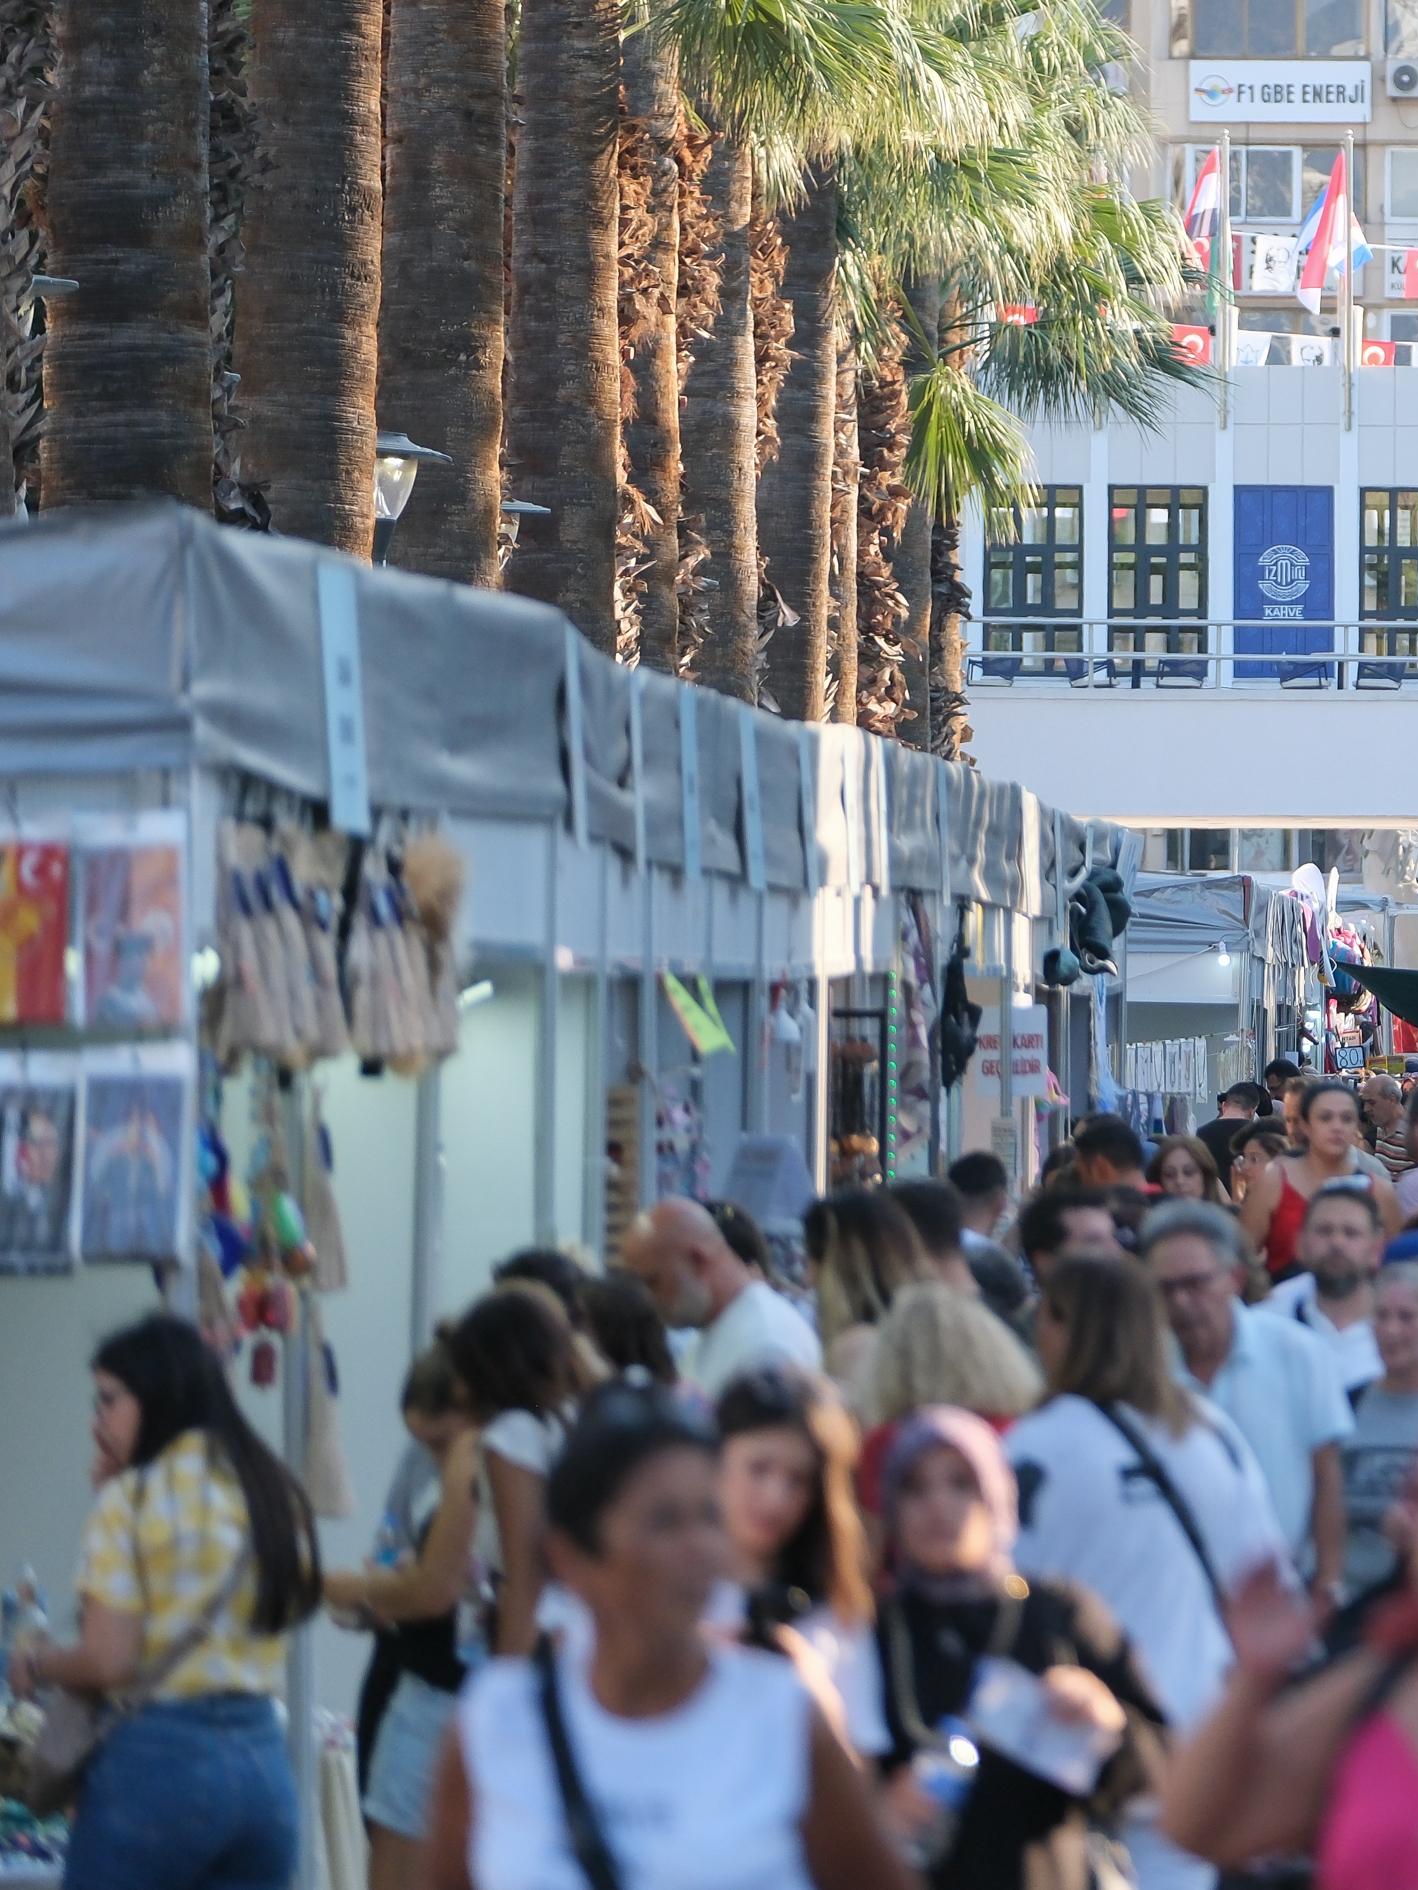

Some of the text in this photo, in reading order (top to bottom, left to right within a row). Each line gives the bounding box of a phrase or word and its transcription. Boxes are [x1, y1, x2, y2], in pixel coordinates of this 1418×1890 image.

[1236, 79, 1366, 104] F1 GBE ENERJİ
[1264, 605, 1304, 618] KAHVE
